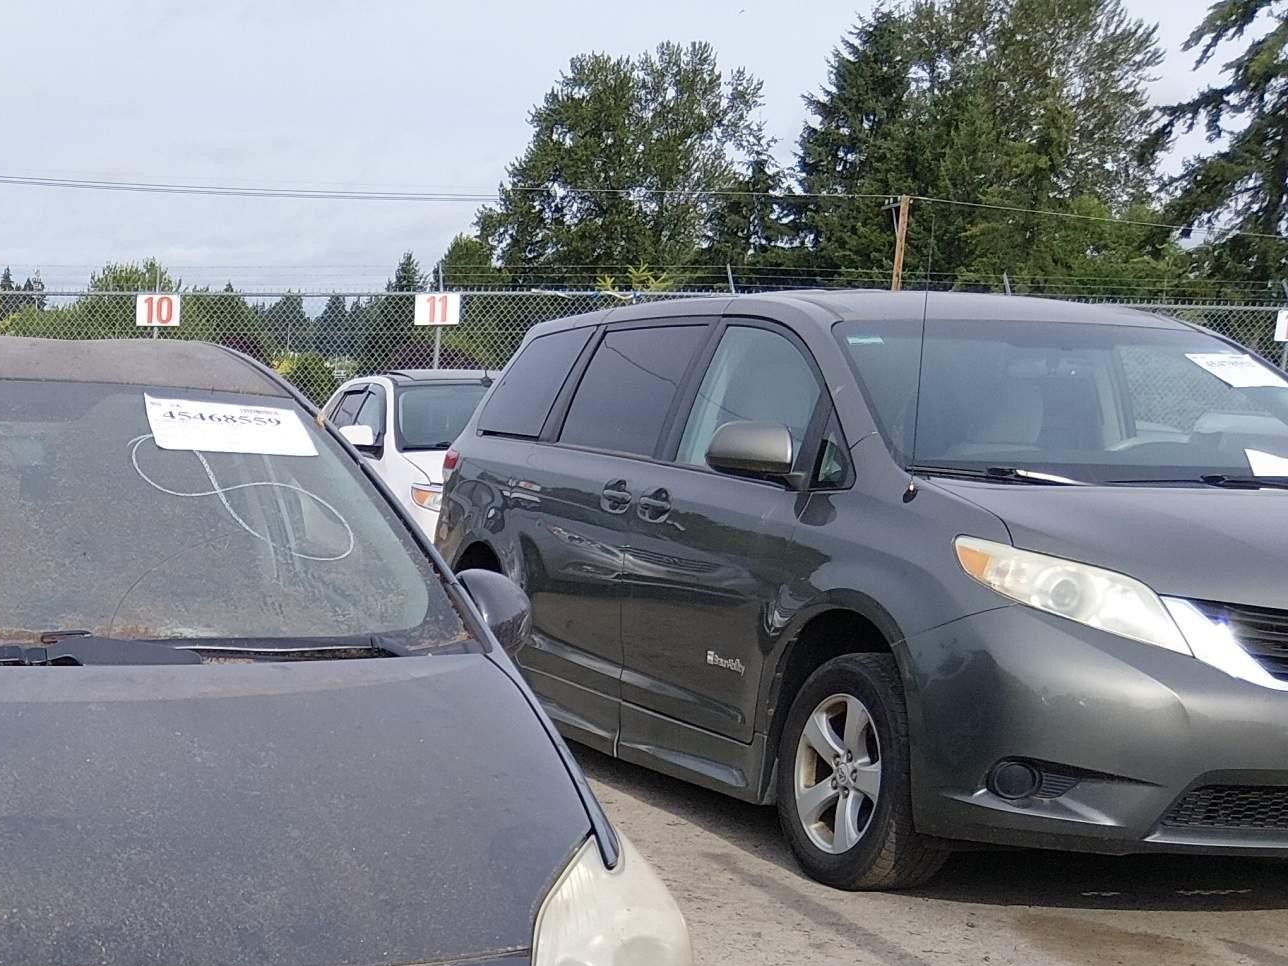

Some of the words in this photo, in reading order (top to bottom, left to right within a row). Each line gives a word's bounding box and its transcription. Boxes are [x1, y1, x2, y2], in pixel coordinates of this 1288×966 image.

[145, 297, 173, 325] 10
[425, 296, 449, 323] 11
[163, 409, 281, 427] 45468559
